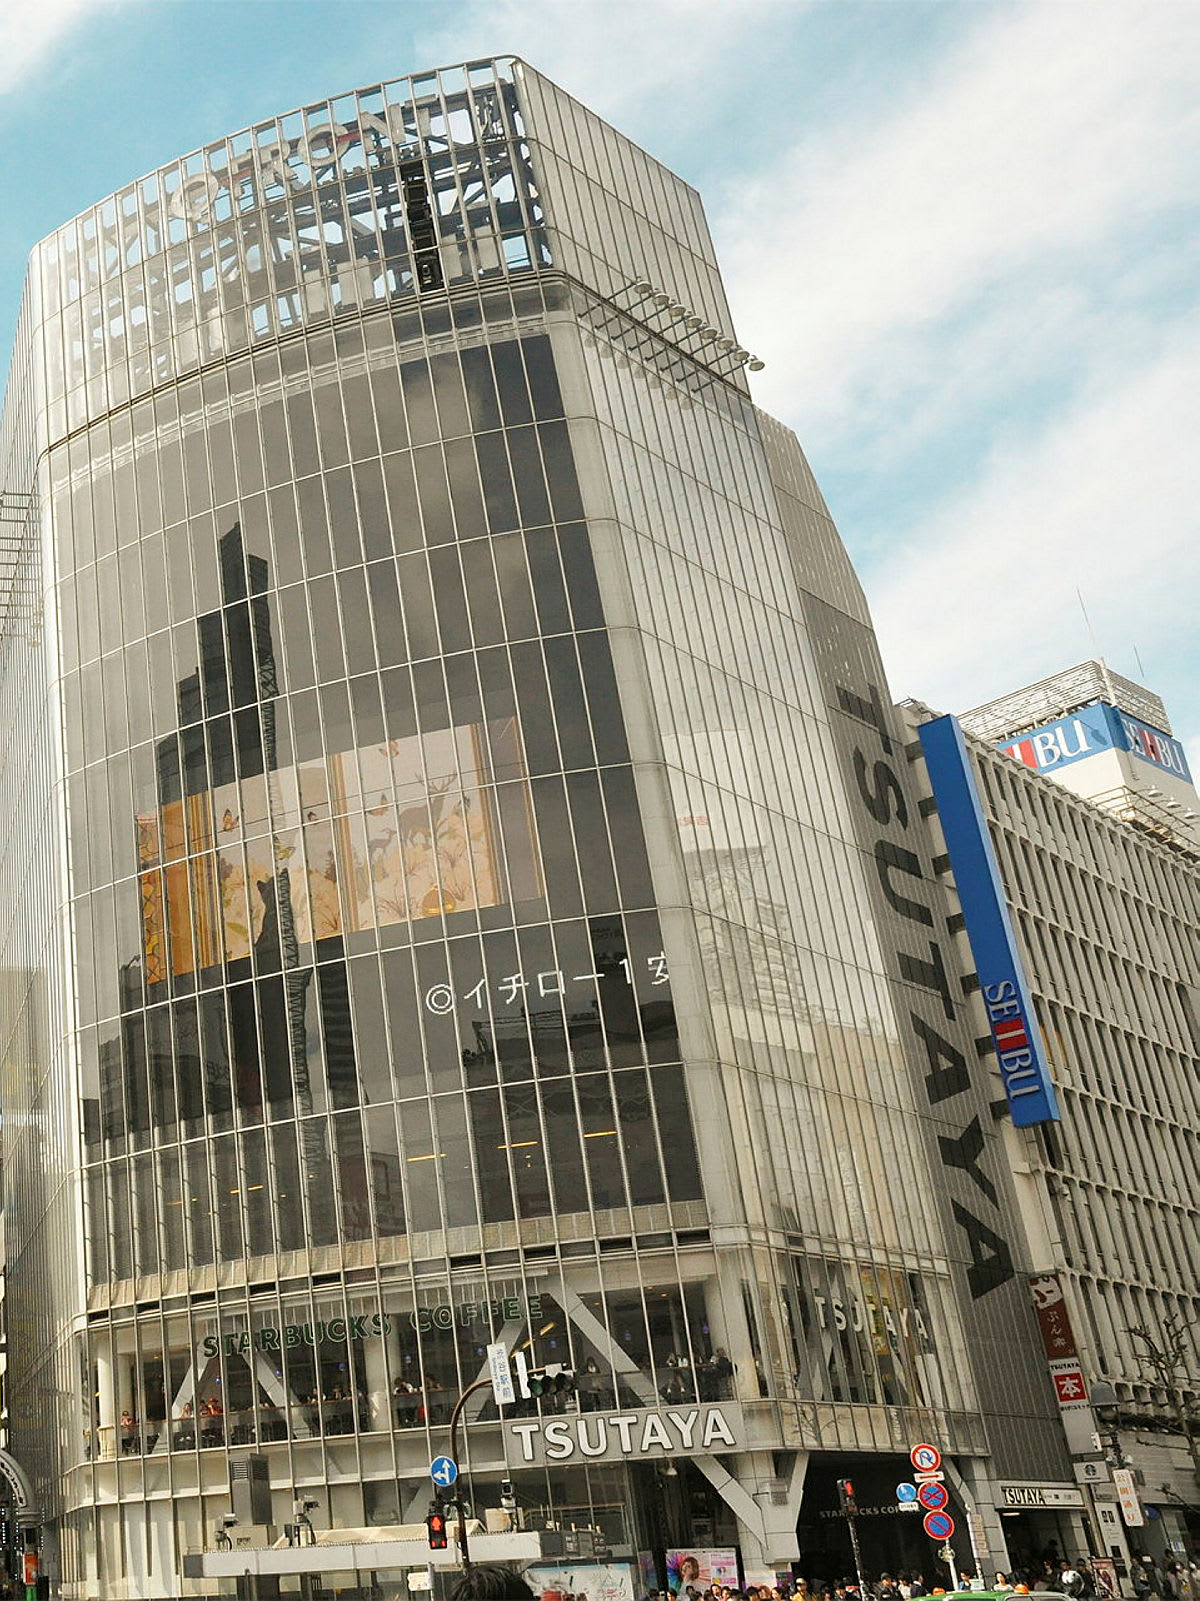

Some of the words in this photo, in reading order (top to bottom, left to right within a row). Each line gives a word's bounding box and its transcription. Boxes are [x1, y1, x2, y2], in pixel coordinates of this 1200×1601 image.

[836, 684, 1015, 1300] TSUTAYA
[984, 978, 1040, 1102] SEIBU
[203, 1312, 392, 1359] STARBUCKS
[409, 1294, 543, 1333] COFFEE
[814, 1296, 929, 1340] TSUTAYA
[1050, 1362, 1082, 1371] TSUTAYA
[1058, 1376, 1081, 1398] 本
[511, 1408, 737, 1462] TSUTAYA
[1001, 1486, 1046, 1506] TSUTAYA
